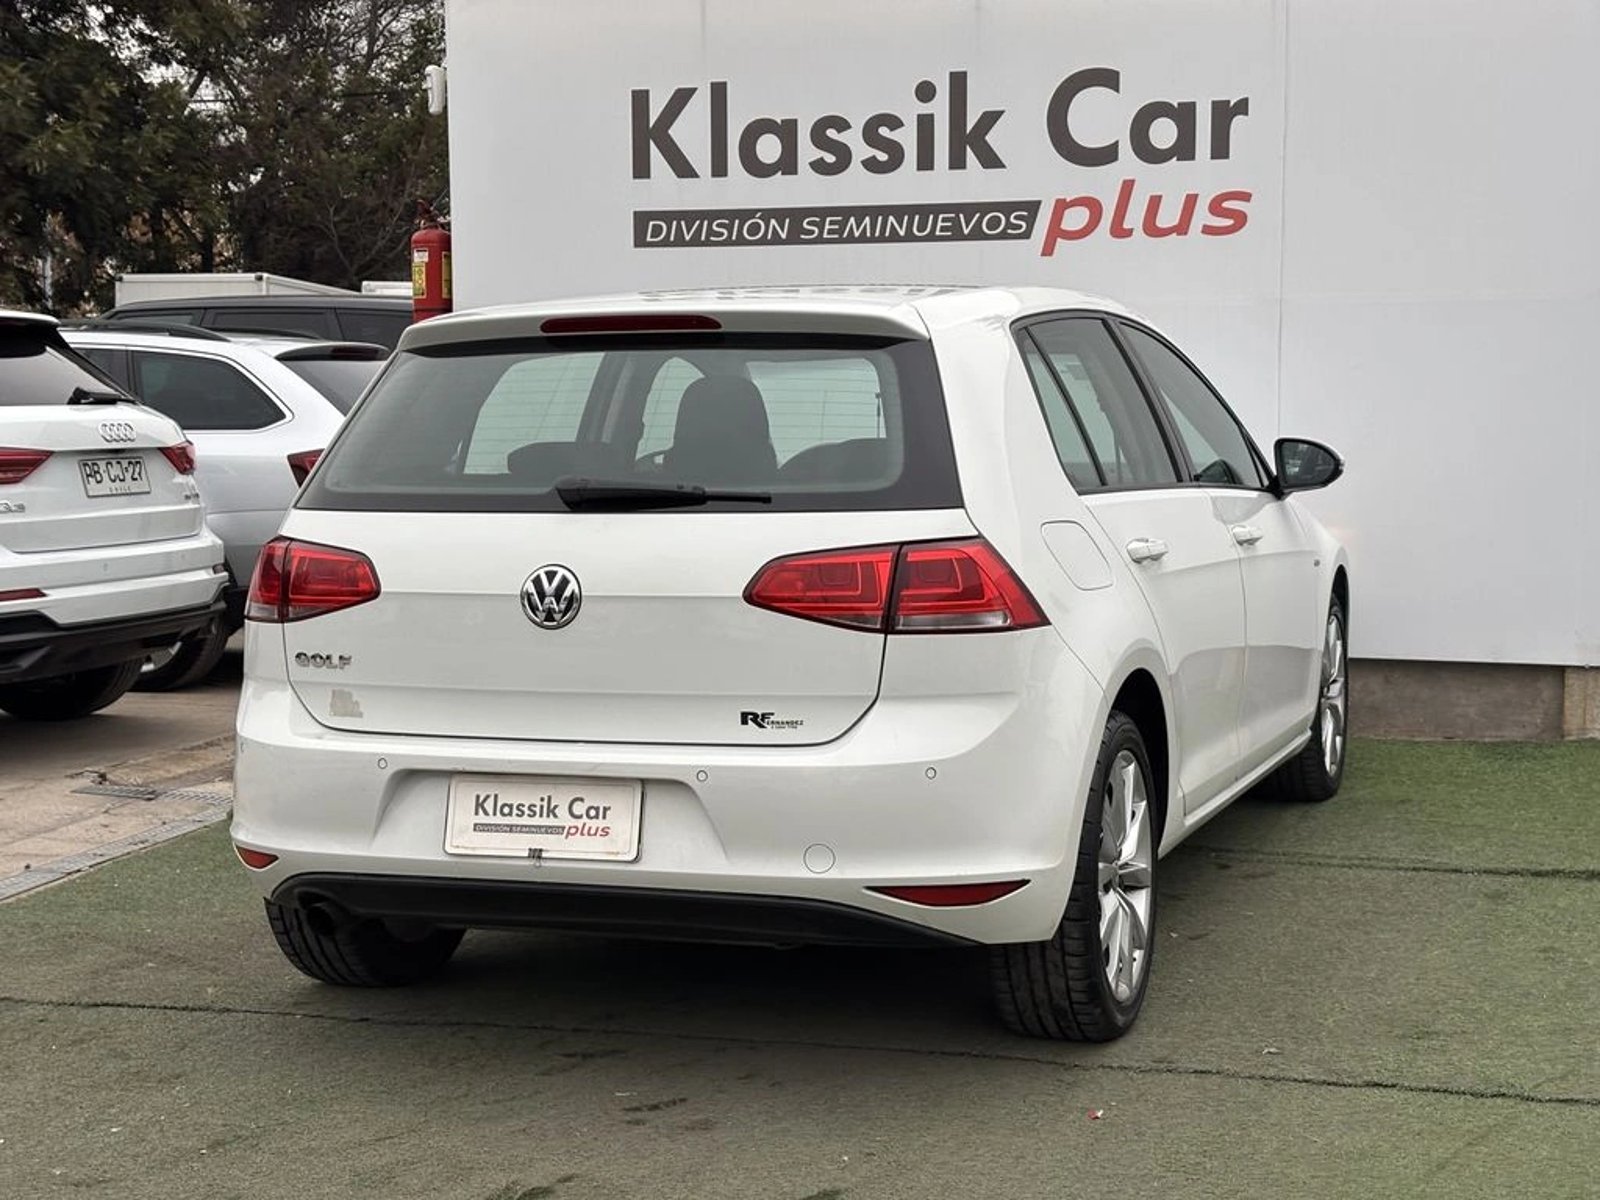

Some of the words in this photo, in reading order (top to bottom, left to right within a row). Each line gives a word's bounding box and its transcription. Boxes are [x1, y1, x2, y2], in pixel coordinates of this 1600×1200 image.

[631, 71, 1007, 180] Klassik
[1046, 67, 1249, 168] Car
[645, 212, 789, 243] DIVISIÓN
[799, 210, 1029, 240] SEMINUEVOS
[1041, 179, 1252, 257] plus
[294, 652, 352, 669] GOLF
[474, 793, 559, 819] Klassik
[567, 796, 611, 821] Car
[511, 825, 564, 835] SEMINUEVOS
[564, 822, 611, 840] plus
